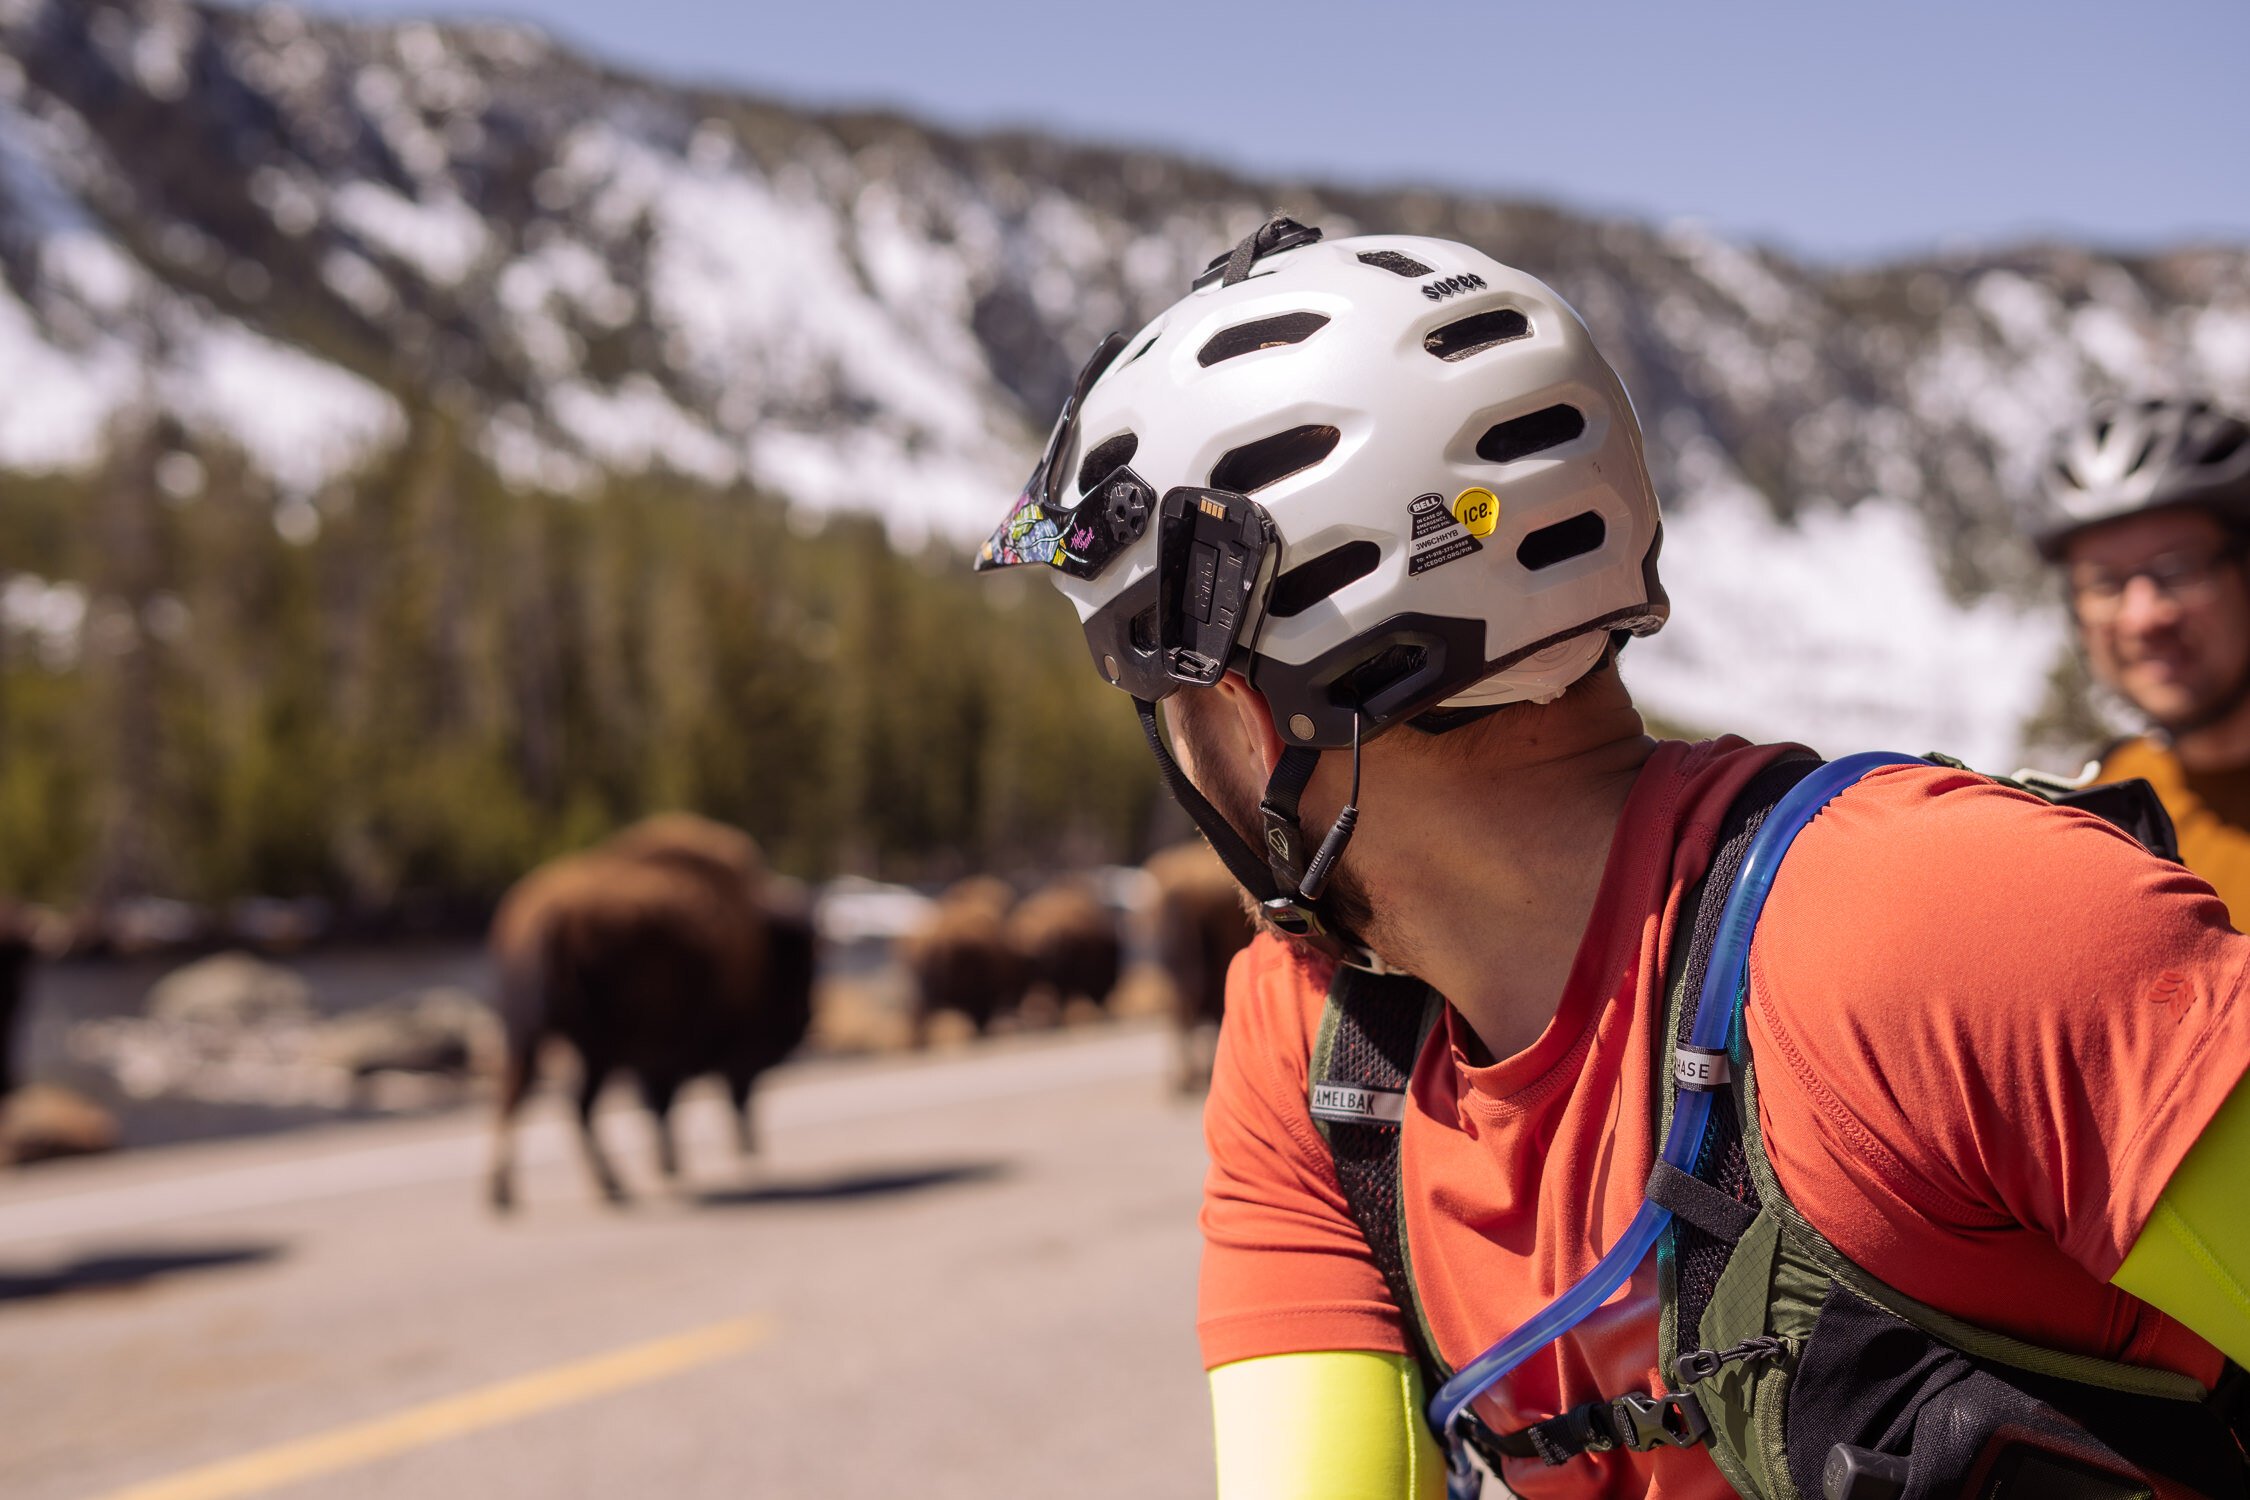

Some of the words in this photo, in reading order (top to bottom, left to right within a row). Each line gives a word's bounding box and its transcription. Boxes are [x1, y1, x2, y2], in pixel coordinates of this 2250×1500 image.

[1412, 497, 1438, 512] BELL
[1423, 513, 1436, 522] CASE
[1416, 527, 1429, 536] TEXT
[1430, 523, 1441, 531] THIS
